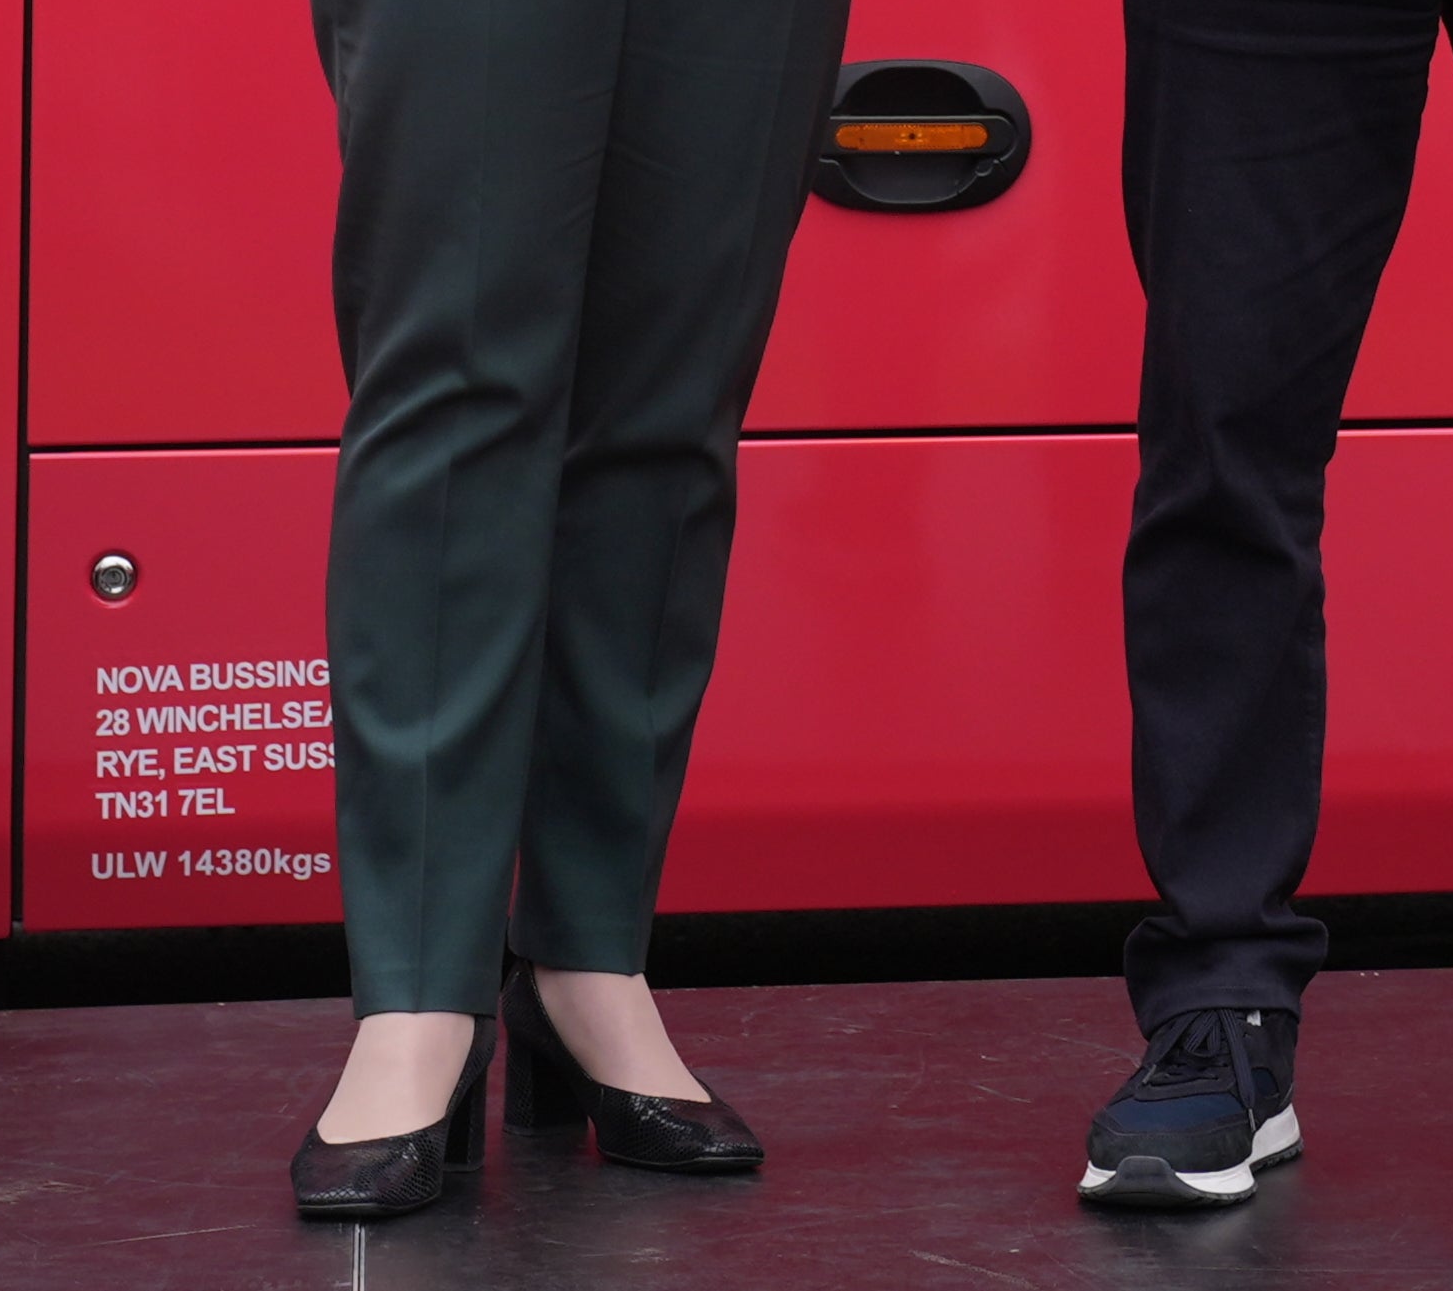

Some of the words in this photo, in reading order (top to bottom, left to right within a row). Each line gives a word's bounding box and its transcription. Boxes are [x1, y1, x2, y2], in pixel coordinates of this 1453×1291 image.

[97, 665, 184, 694] NOVA
[191, 659, 330, 690] BUSSING
[96, 709, 130, 736] 28
[97, 749, 165, 779] RYE,
[174, 745, 256, 774] EAST
[264, 742, 336, 770] SUS
[95, 790, 167, 819] TN31
[178, 788, 235, 815] 7EL
[92, 851, 167, 879] ULW
[179, 848, 331, 880] 14380kgs
